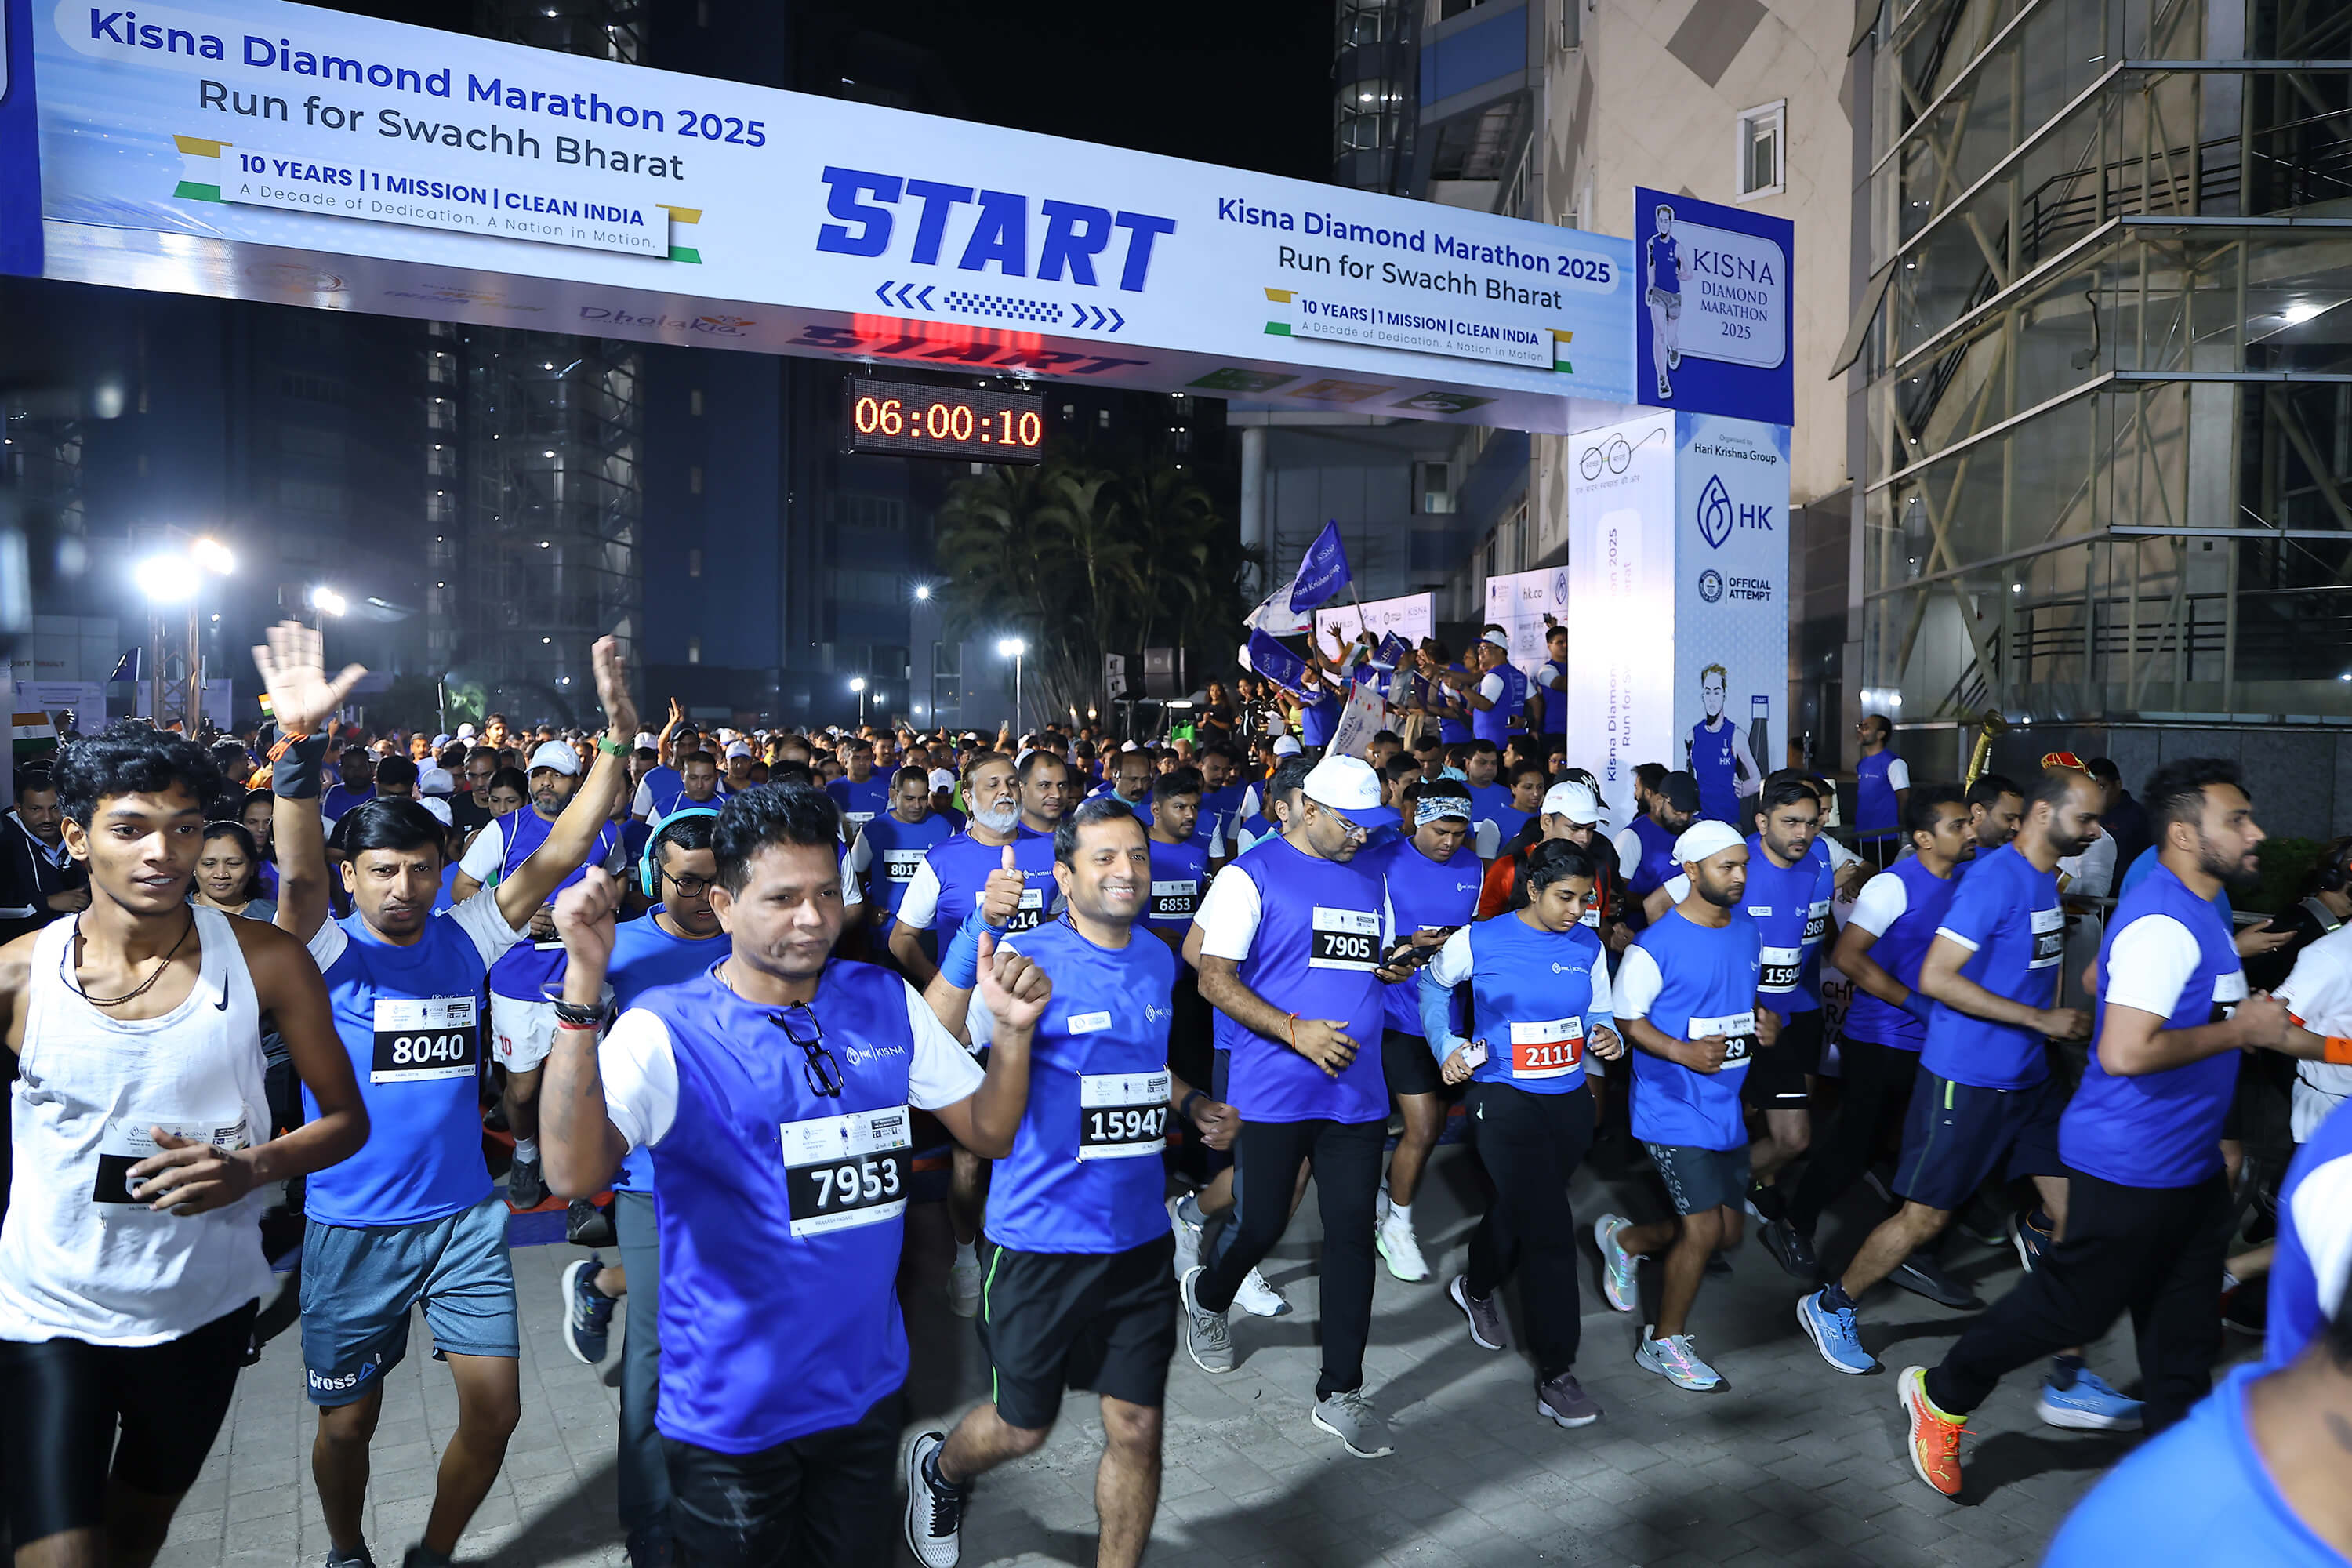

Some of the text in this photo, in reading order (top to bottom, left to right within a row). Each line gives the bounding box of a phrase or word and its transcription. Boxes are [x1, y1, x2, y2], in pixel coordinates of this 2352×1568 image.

[90, 7, 767, 147] Kisna Diamond Marathon 2025
[200, 79, 684, 180] Run for Swachh Bharat
[240, 154, 645, 227] 10 YEARS 1 MISSION CLEAN INDIA
[240, 183, 656, 249] A Decade of Dedication. A Nation in Motion.
[816, 165, 1178, 293] START
[1218, 197, 1612, 284] Kisna Diamond Marathon 2025
[1279, 245, 1563, 310] Run for Swachh Bharat
[1693, 248, 1775, 285] KISNA
[1701, 280, 1769, 306] DIAMOND
[579, 307, 746, 337] Dholakia
[1301, 299, 1540, 347] 10 YEARS 1 MISSION CLEAN INDIA
[1700, 300, 1769, 321] MARATHON
[1301, 321, 1309, 332] A
[1312, 321, 1359, 338] Decade
[1363, 328, 1374, 339] of
[1446, 339, 1454, 350] A
[1457, 339, 1491, 356] Nation
[1495, 345, 1505, 357] in
[1721, 321, 1751, 339] 2025
[786, 325, 1151, 375] START
[855, 396, 1042, 448] 06:00:10
[1694, 442, 1777, 465] Hari Krishna Group
[1740, 503, 1774, 531] HK
[1607, 528, 1618, 567] 2025
[1523, 587, 1543, 601] hk.co
[1729, 576, 1772, 590] OFFICIAL
[1729, 588, 1772, 602] ATTEMPT
[1607, 660, 1617, 731] Diamon
[1621, 689, 1631, 710] for
[1622, 715, 1631, 746] Run
[1607, 738, 1617, 782] Kisna
[1719, 757, 1731, 766] HK
[891, 863, 918, 877] 801
[1159, 898, 1191, 912] 6853
[1323, 935, 1371, 959] 7905
[392, 1033, 465, 1065] 8040
[499, 1034, 513, 1056] 10
[859, 1044, 906, 1059] HK KISNA
[1525, 1044, 1576, 1067] 2111
[1091, 1106, 1168, 1142] 15947
[811, 1157, 900, 1209] 7953
[309, 1368, 357, 1392] Cross
